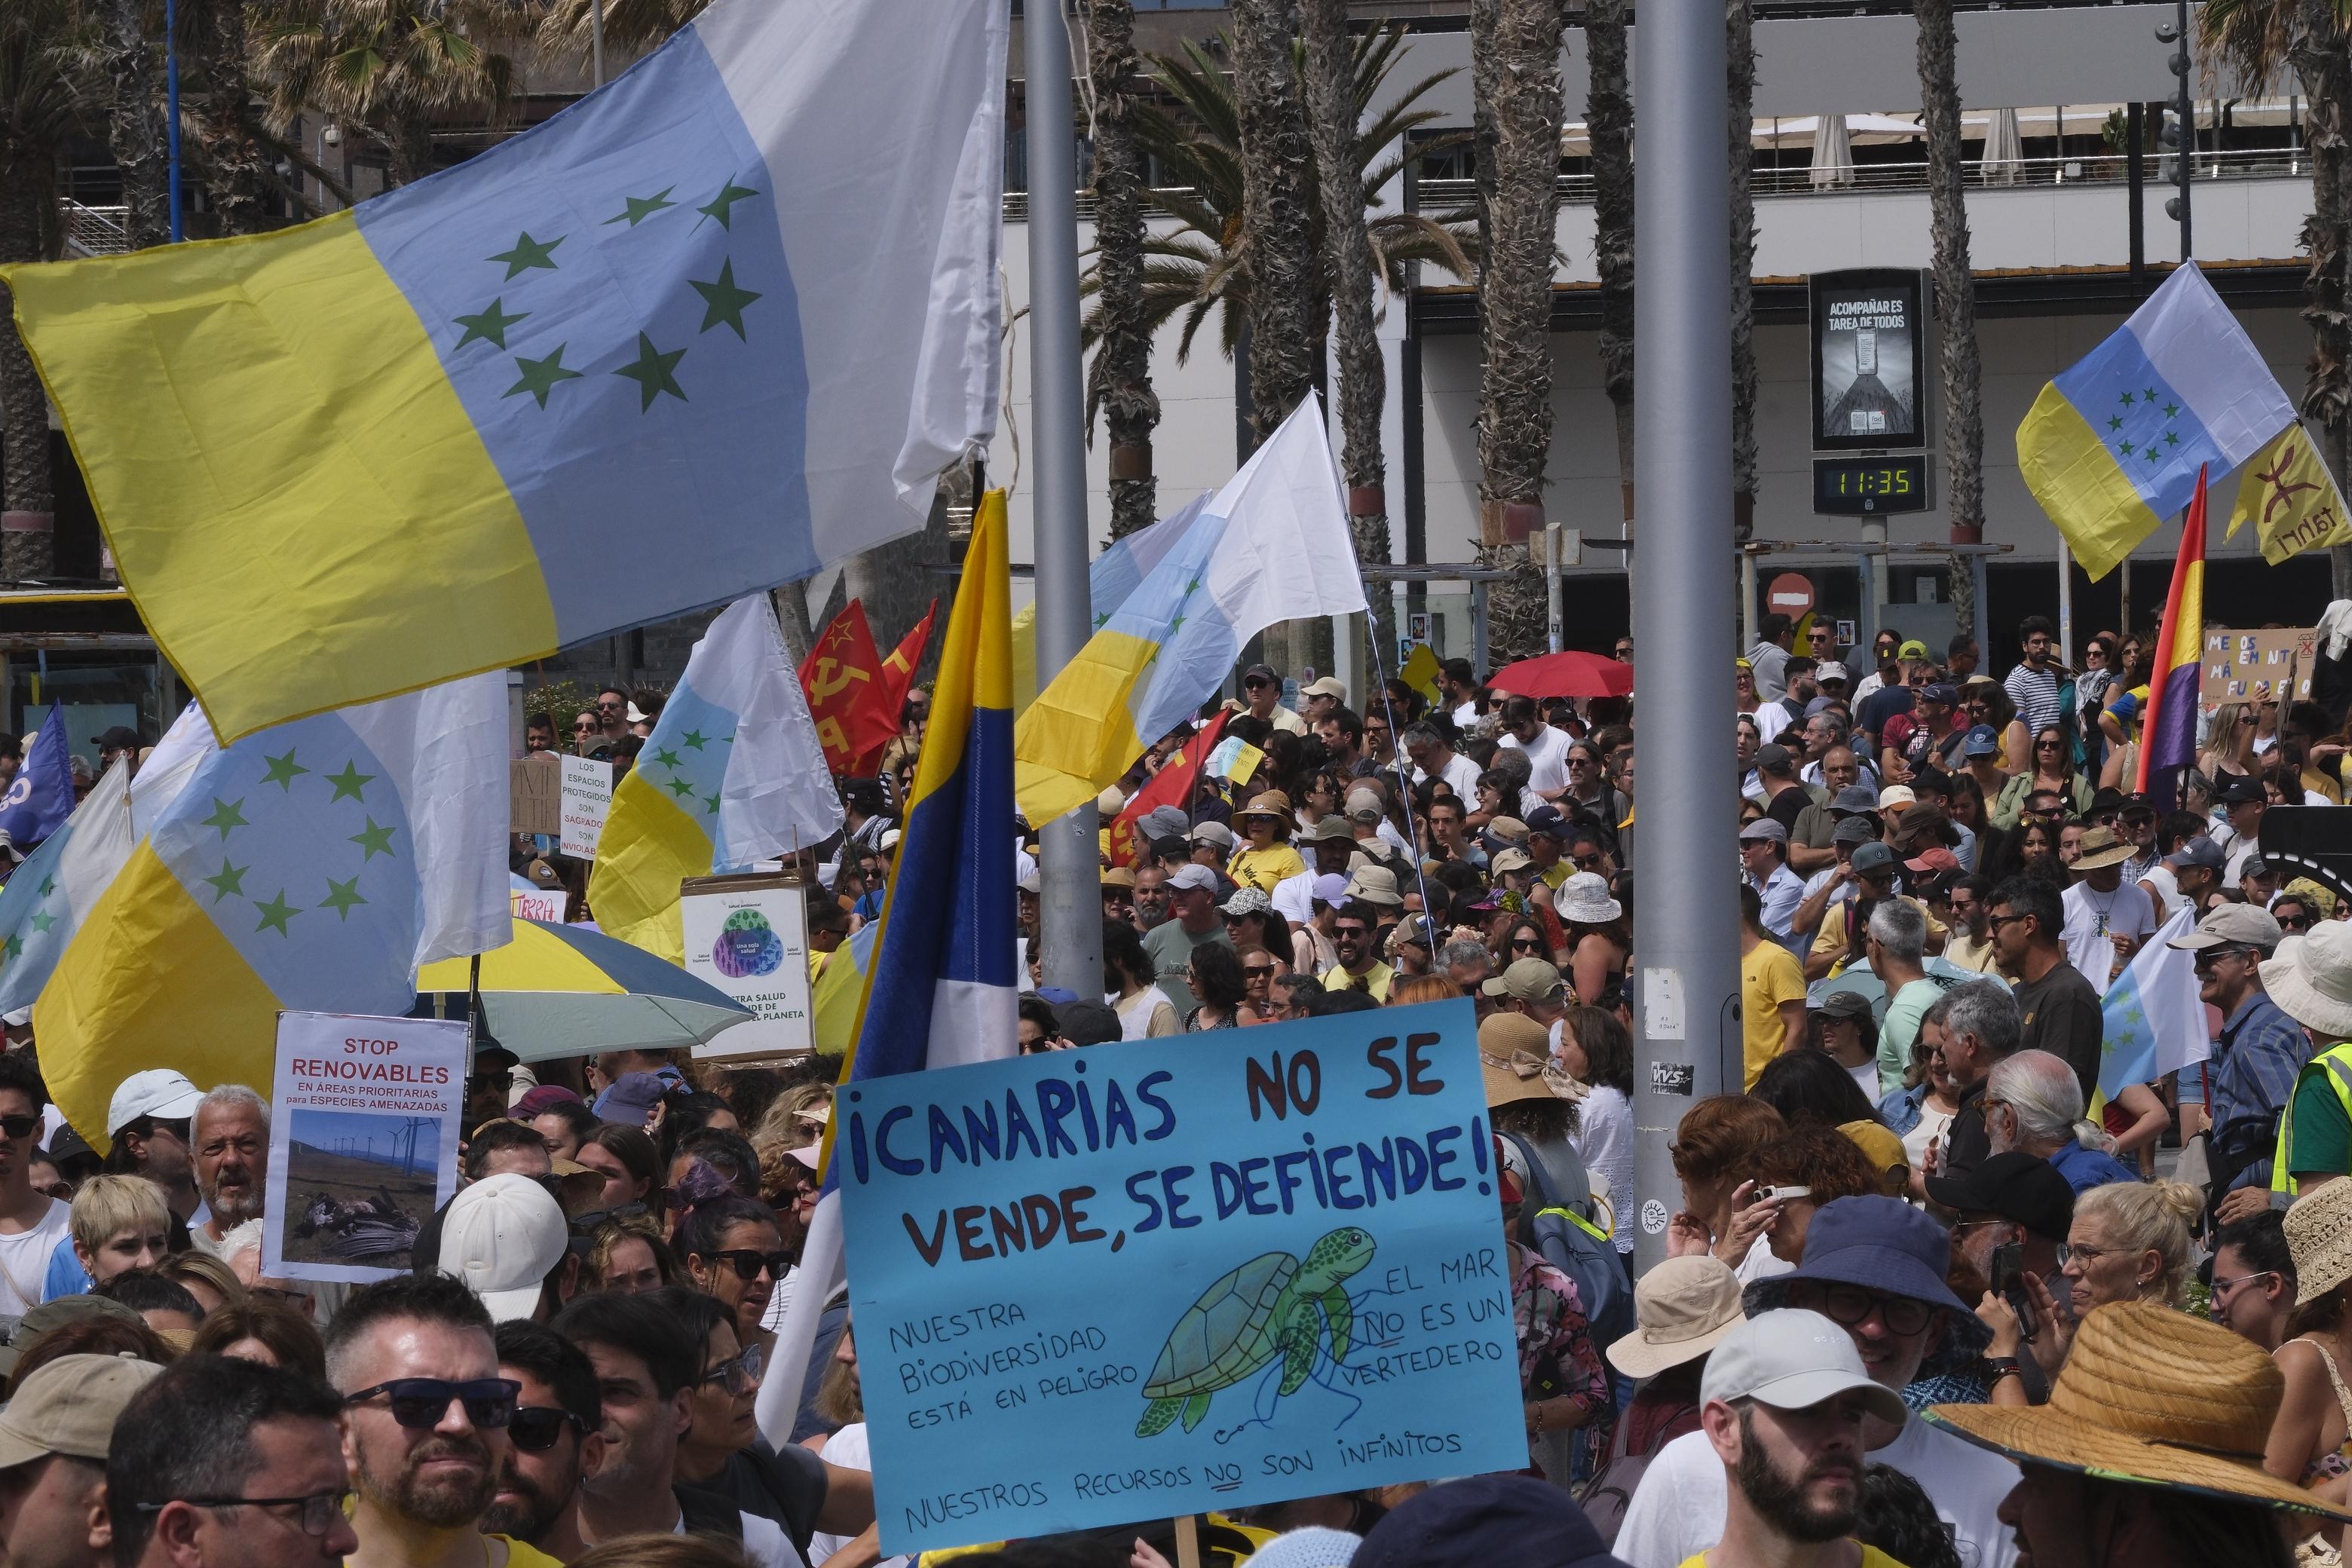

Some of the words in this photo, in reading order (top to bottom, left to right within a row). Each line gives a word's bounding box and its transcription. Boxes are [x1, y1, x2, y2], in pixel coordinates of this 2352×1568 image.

[1830, 299, 1890, 315] ACOMPAÑAR
[1891, 300, 1903, 313] ES
[1828, 317, 1858, 331] TAREA
[1860, 317, 1872, 327] DE
[1873, 315, 1904, 329] TODOS
[1840, 470, 1909, 495] 11:35
[579, 762, 595, 772] LOS
[568, 773, 605, 789] ESPACIOS
[562, 786, 611, 803] PROTEGIDOS
[578, 804, 594, 813] SON
[565, 815, 605, 828] SAGRADO
[578, 831, 594, 841] SON
[561, 841, 596, 855] INVIOLAB
[756, 993, 786, 1002] SALUD
[764, 1010, 804, 1020] PLANETA
[344, 1038, 399, 1055] STOP
[292, 1058, 449, 1084] RENOVABLES
[1246, 1049, 1321, 1122] NO
[1364, 1032, 1445, 1099] SE
[298, 1082, 313, 1092] EN
[316, 1082, 355, 1094] ÁREAS
[359, 1086, 438, 1099] PRIORITARIAS
[286, 1096, 307, 1104] para
[310, 1095, 366, 1107] ESPECIES
[369, 1100, 448, 1112] AMENAZADAS
[1125, 1165, 1203, 1233] SE
[1386, 1265, 1424, 1294] EL
[1441, 1248, 1499, 1284] MAR
[1364, 1311, 1404, 1344] NO
[1422, 1303, 1455, 1331] ES
[1467, 1290, 1505, 1322] UN
[890, 1303, 1026, 1353] NUESTRA
[1342, 1340, 1502, 1386] VERTEDERO
[908, 1391, 972, 1429] ESTÁ
[995, 1385, 1027, 1409] EN
[905, 1482, 1048, 1533] NUESTROS
[1073, 1466, 1192, 1500] RECURSOS
[1204, 1462, 1242, 1483] NO
[1261, 1450, 1314, 1475] SON
